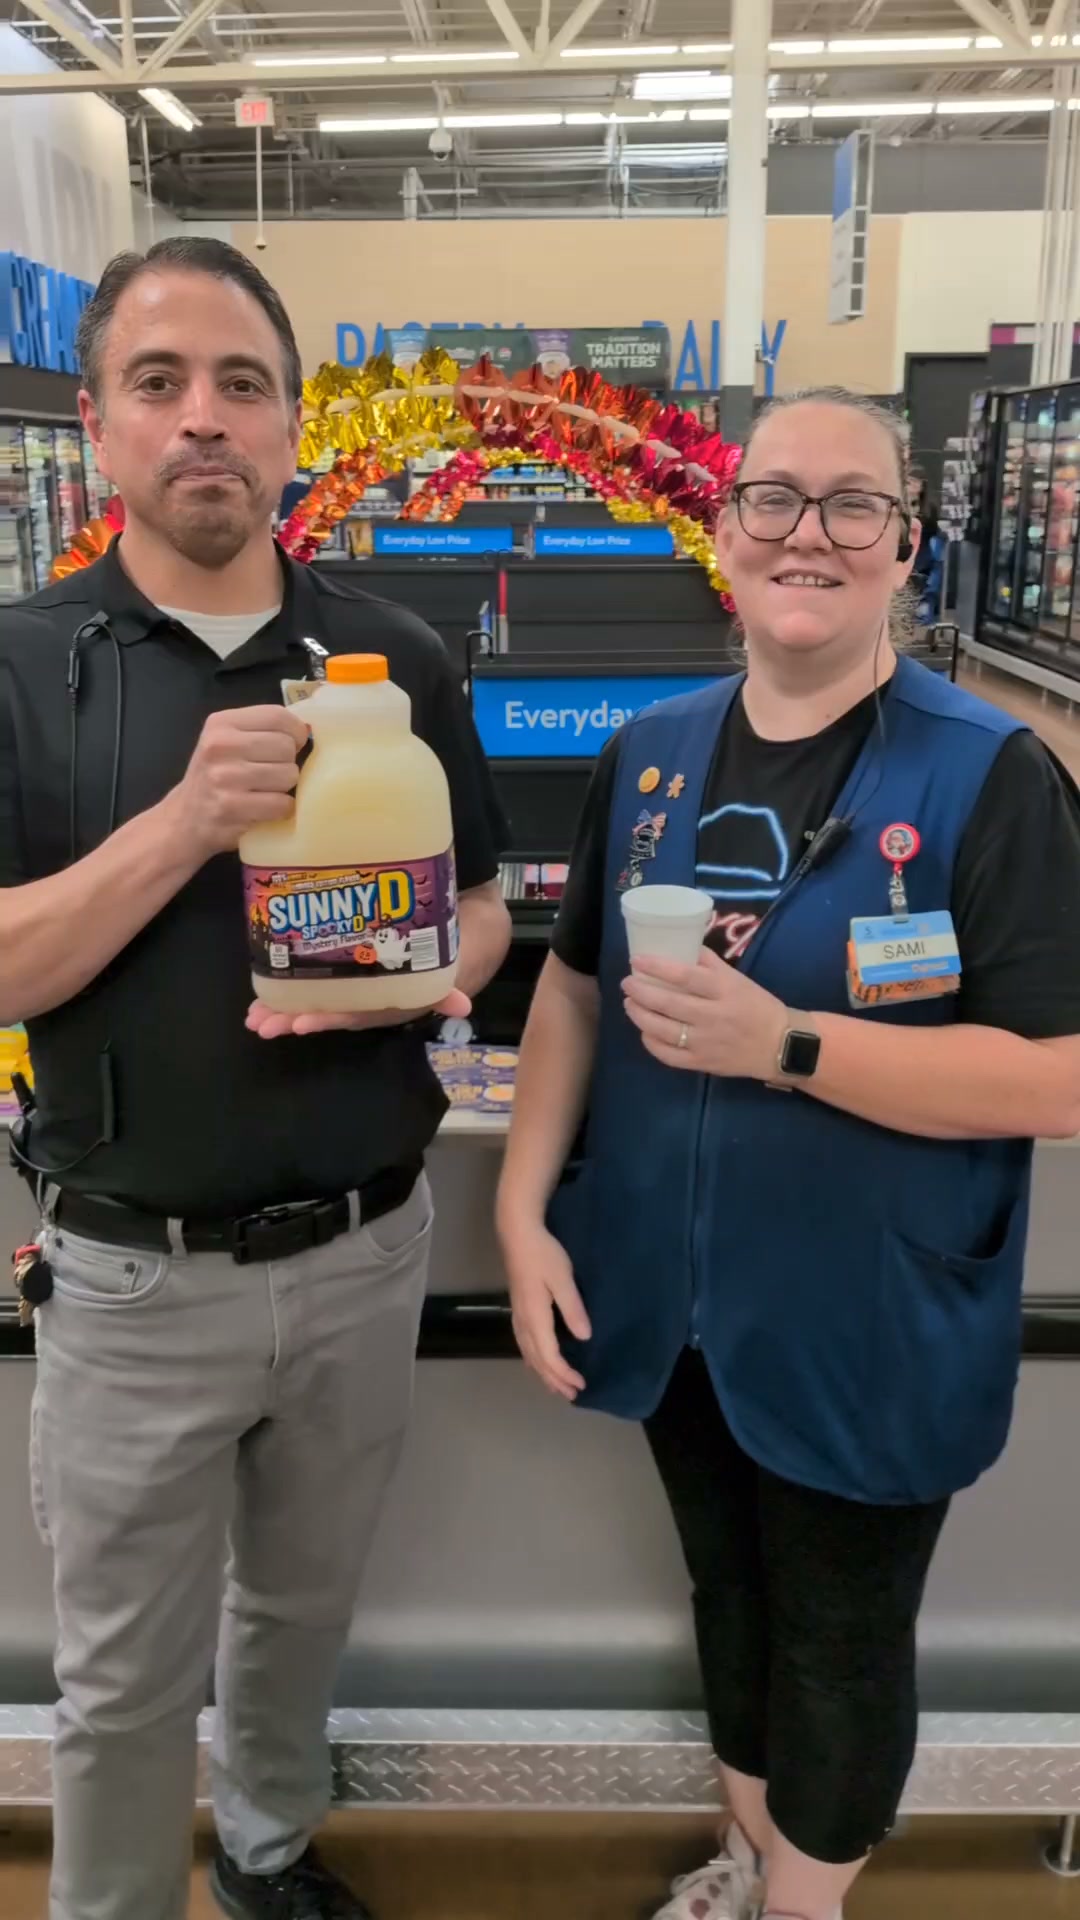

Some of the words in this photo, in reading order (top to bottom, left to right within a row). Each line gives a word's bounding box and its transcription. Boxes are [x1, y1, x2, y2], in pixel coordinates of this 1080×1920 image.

[586, 343, 661, 356] TRADITION
[591, 355, 657, 368] MATTERS
[383, 534, 426, 547] Everyday
[427, 535, 445, 545] Low
[447, 534, 471, 545] Price
[544, 535, 586, 548] Everyday
[588, 536, 606, 546] Low
[608, 535, 632, 546] Price
[303, 938, 338, 951] Mystery
[883, 941, 925, 960] SAMI
